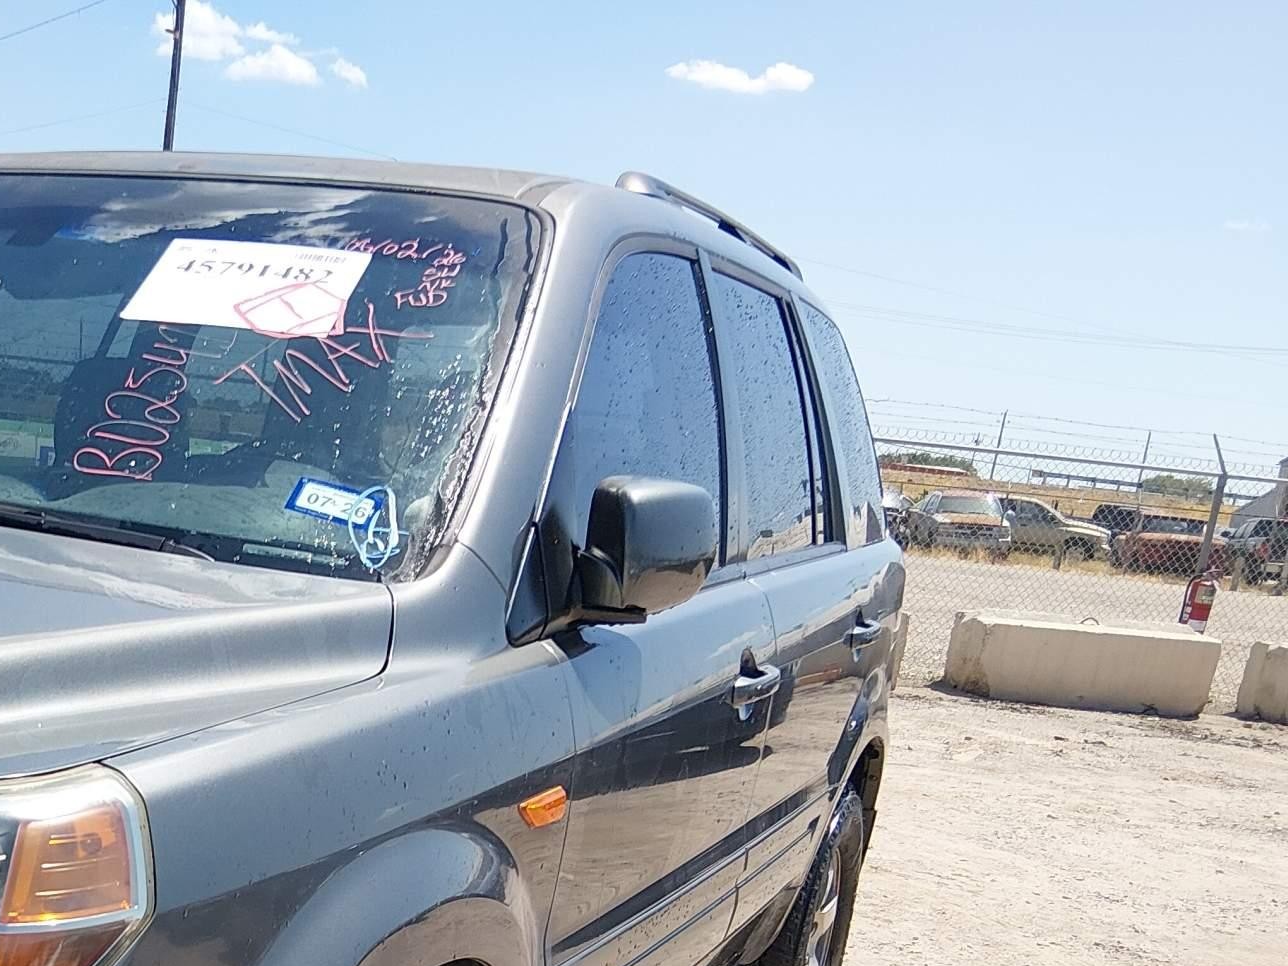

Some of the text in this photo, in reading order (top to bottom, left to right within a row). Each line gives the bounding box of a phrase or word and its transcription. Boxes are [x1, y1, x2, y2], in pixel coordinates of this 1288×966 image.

[177, 259, 334, 284] 45791482
[307, 493, 333, 507] 07
[340, 502, 366, 518] 26
